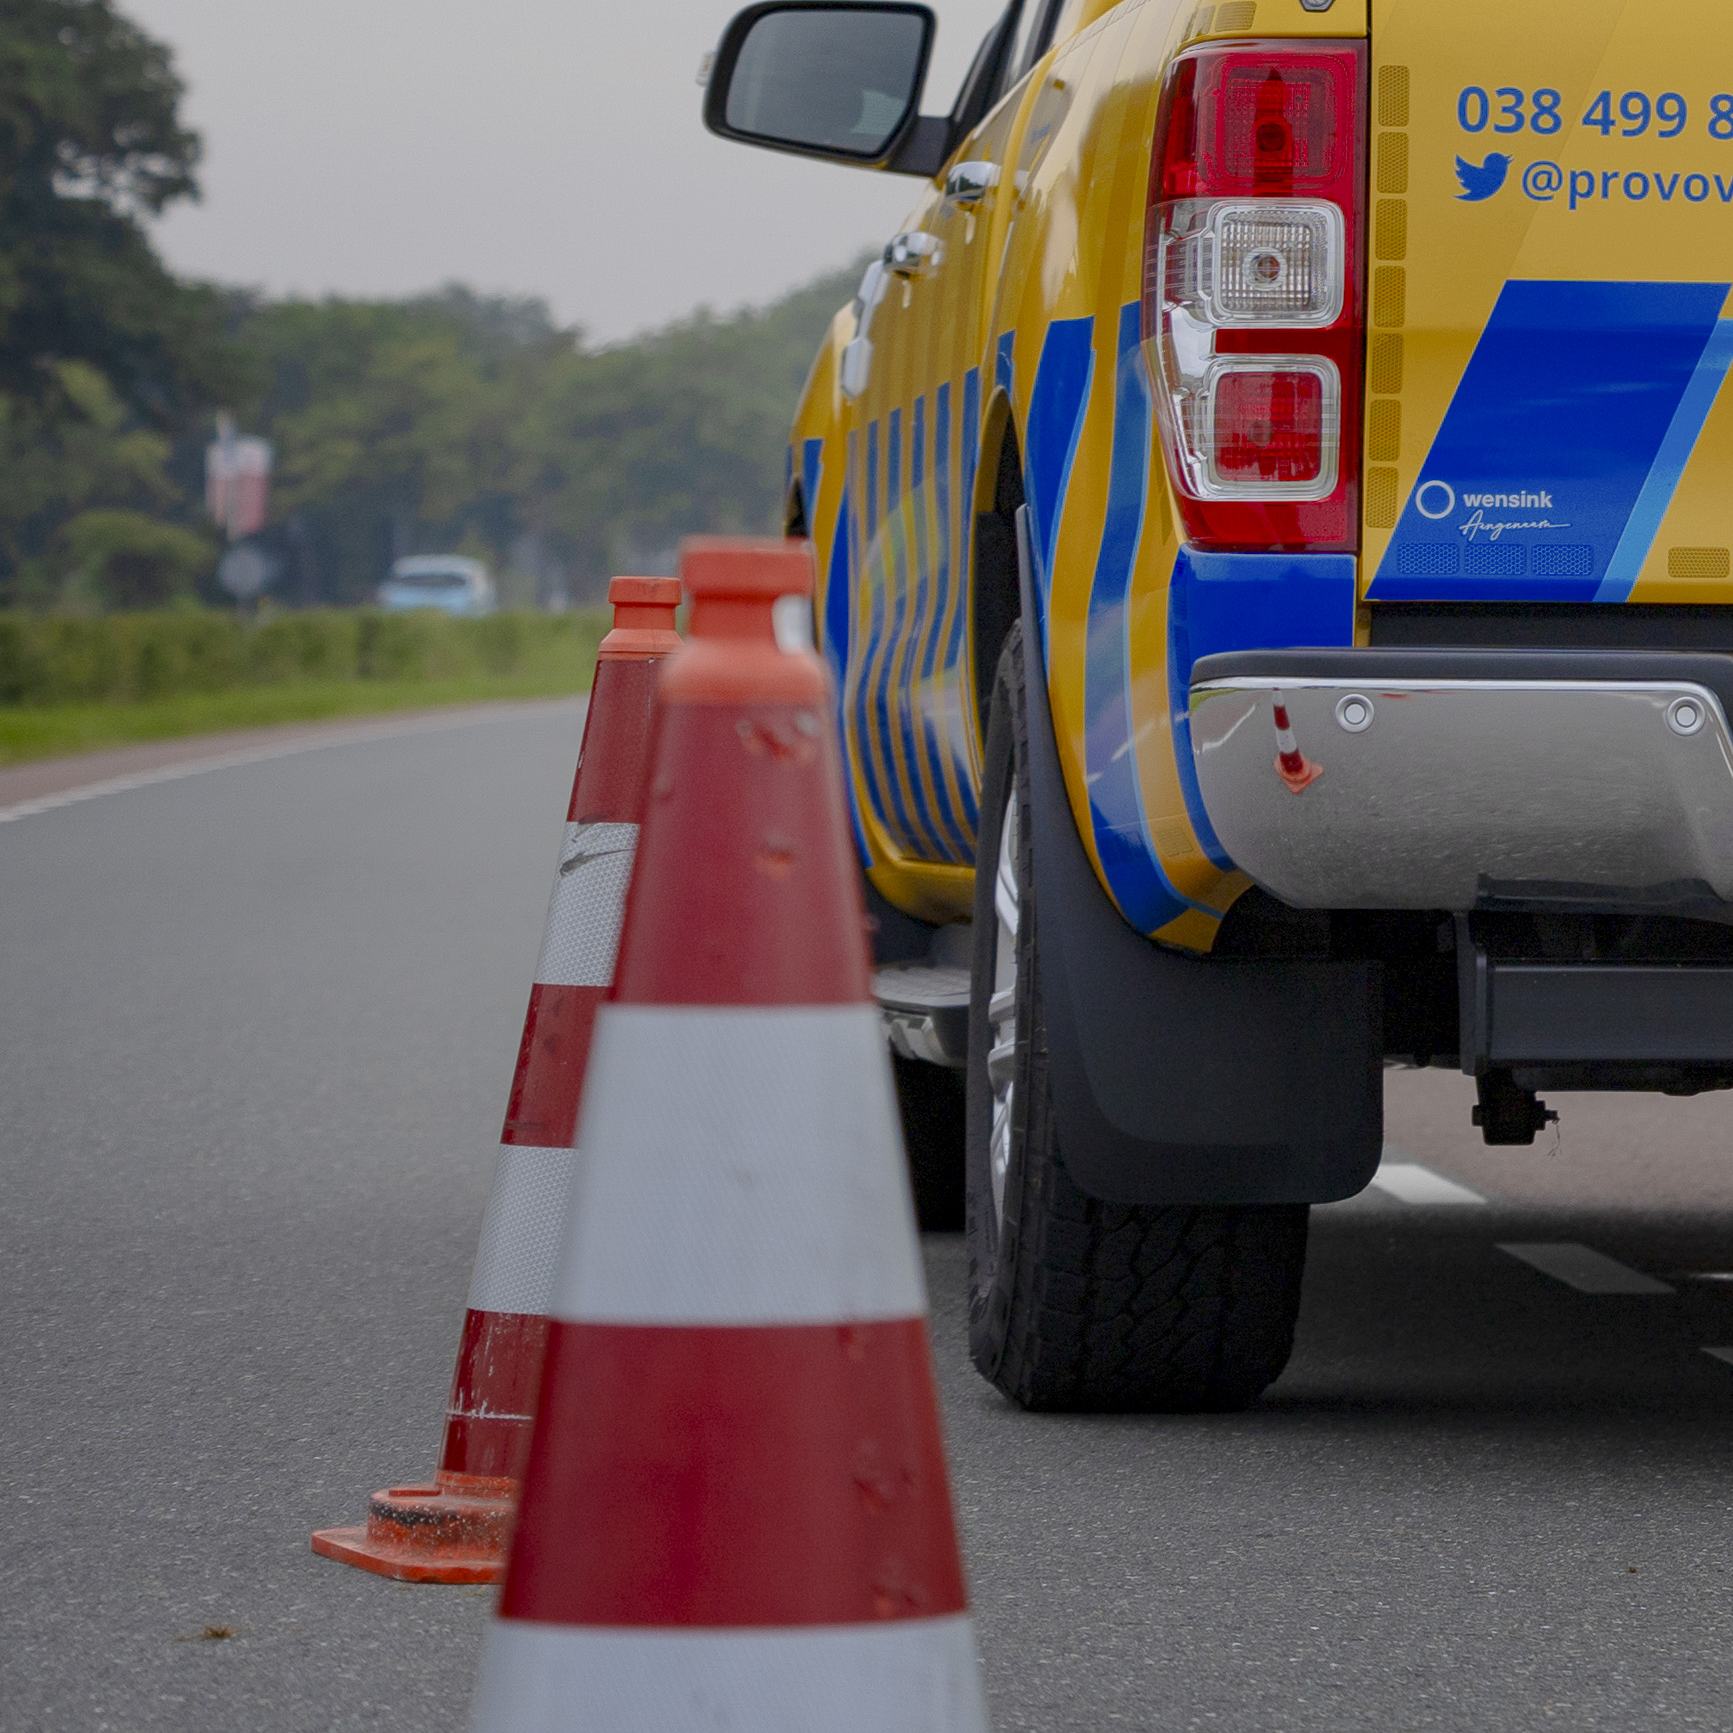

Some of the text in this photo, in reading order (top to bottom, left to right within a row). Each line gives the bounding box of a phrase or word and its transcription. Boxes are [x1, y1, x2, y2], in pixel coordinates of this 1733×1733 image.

[1457, 86, 1562, 135] 038
[1582, 90, 1687, 138] 499
[1463, 490, 1553, 508] wensink
